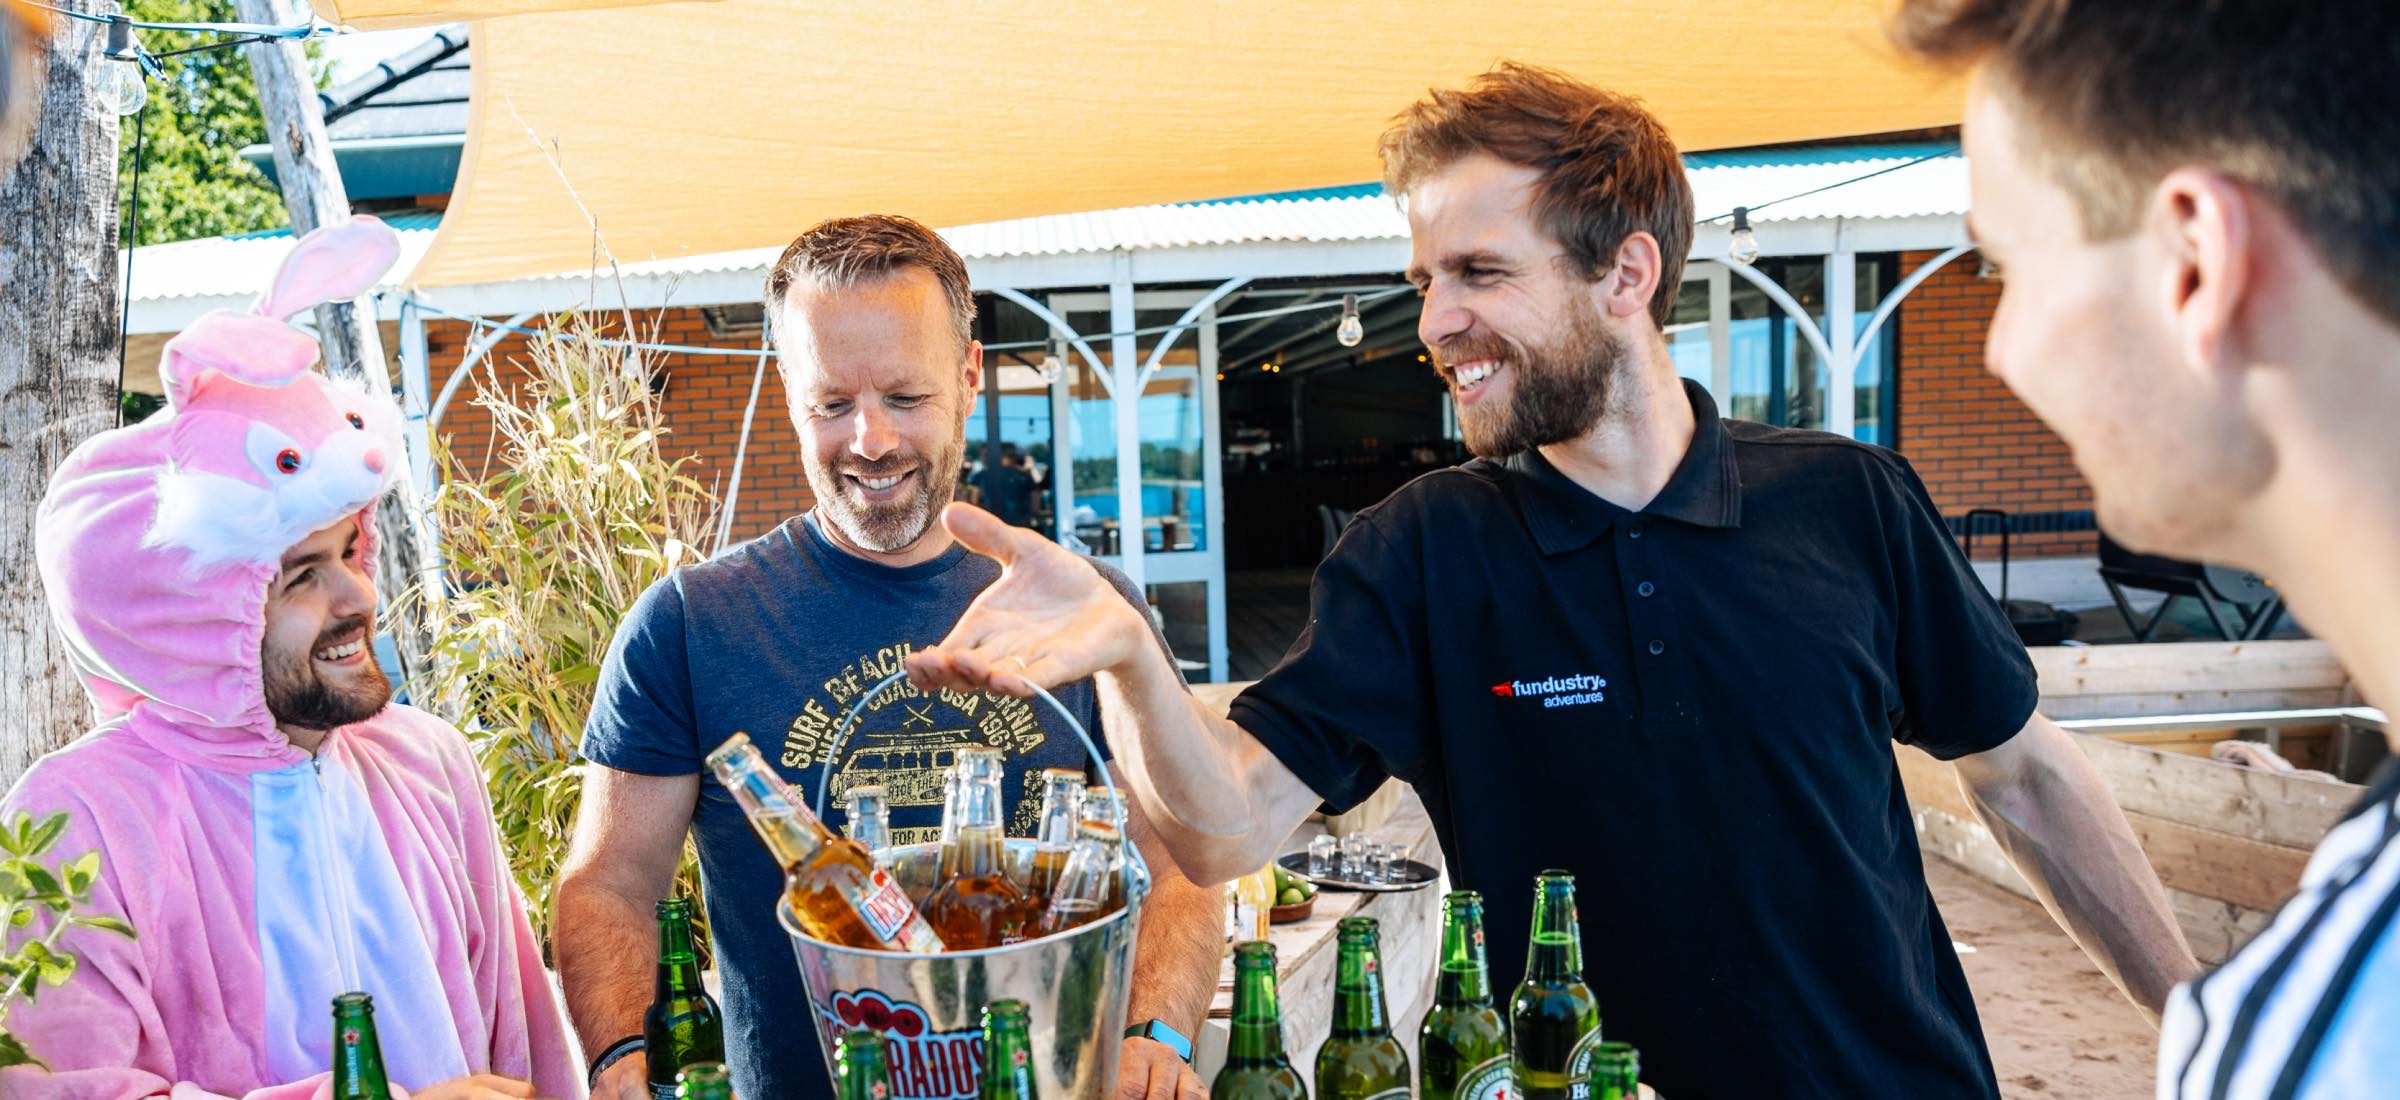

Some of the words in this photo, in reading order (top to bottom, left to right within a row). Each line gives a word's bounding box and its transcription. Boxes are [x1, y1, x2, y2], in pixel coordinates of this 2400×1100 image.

[1512, 673, 1601, 697] fundustry
[780, 698, 831, 769] SURF
[823, 642, 912, 704] BEACH
[1544, 691, 1604, 708] adventures
[815, 704, 864, 765] WEST
[939, 686, 979, 717] USA
[892, 830, 915, 846] FOR
